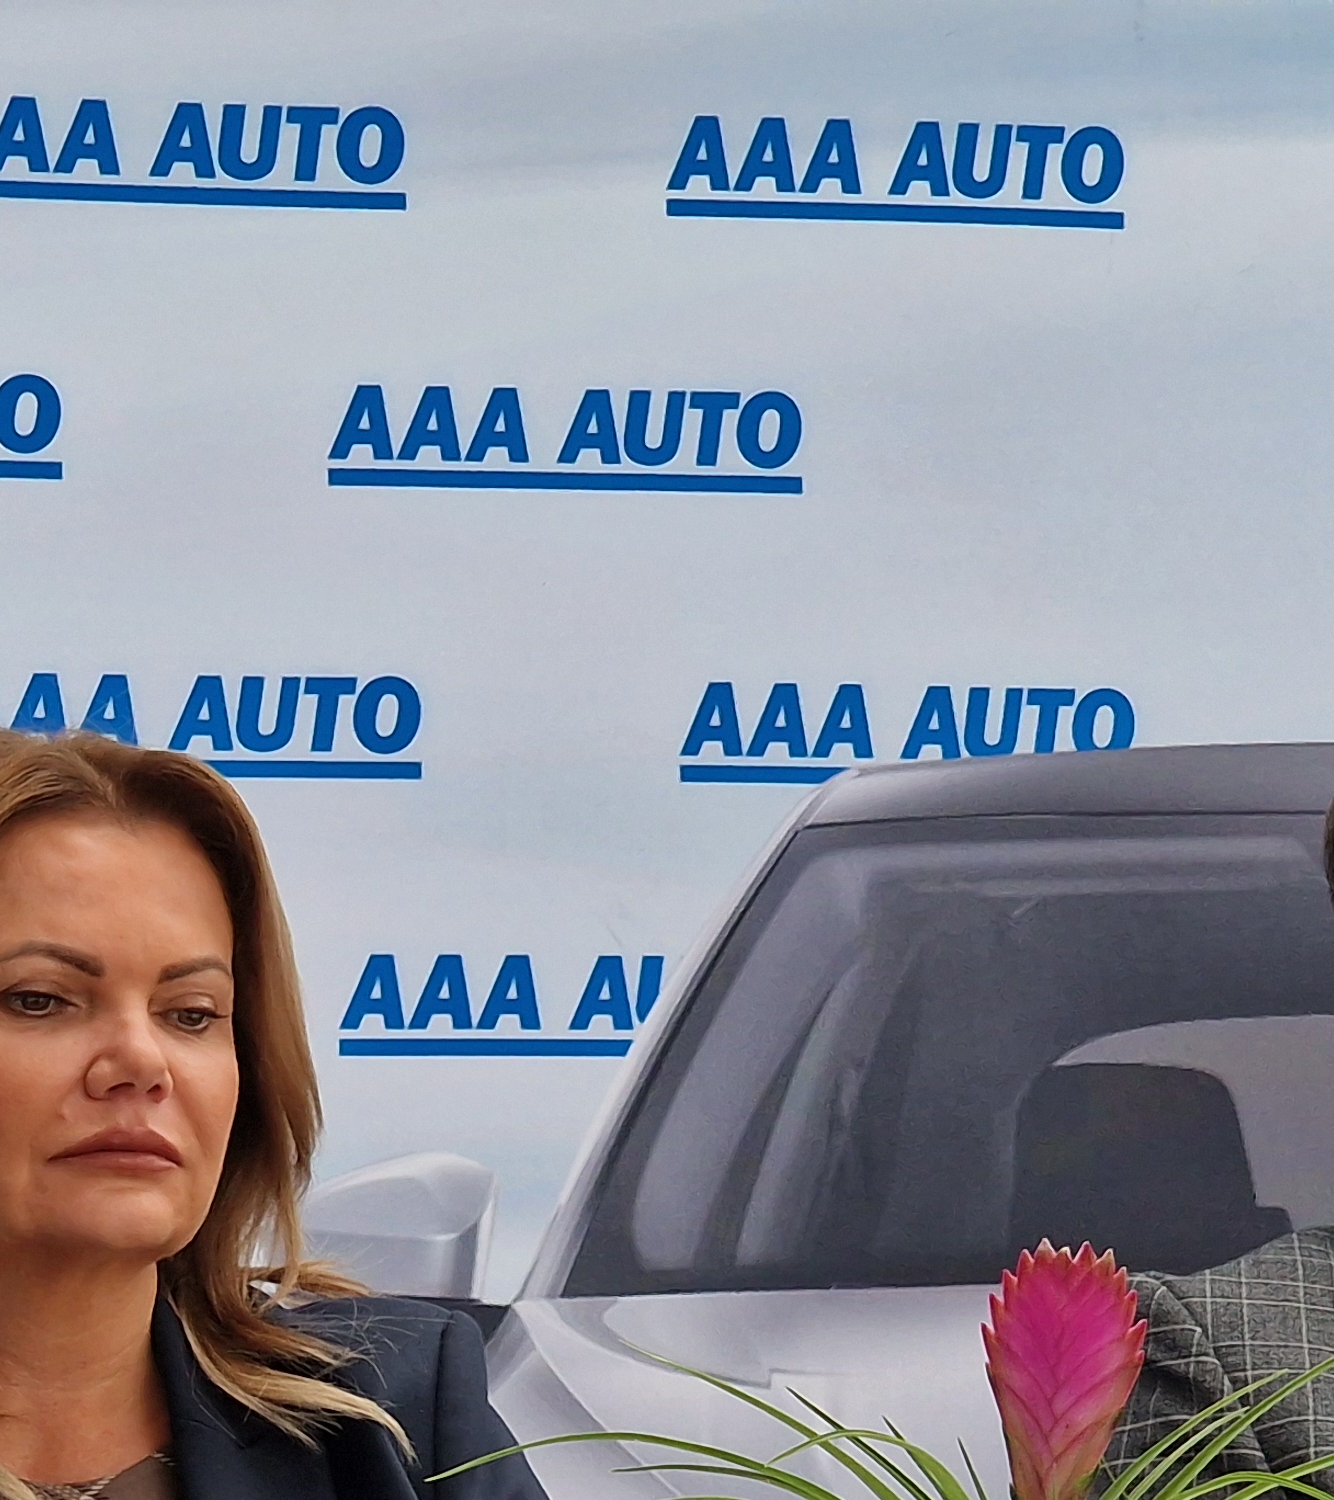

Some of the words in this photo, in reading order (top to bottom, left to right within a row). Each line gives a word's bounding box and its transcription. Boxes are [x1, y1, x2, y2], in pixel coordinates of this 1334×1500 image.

[149, 102, 405, 186] AUTO
[667, 115, 862, 195] AAA
[888, 121, 1125, 205] AUTO
[328, 385, 532, 464] AAA
[557, 389, 802, 470] AUTO
[168, 675, 422, 755] AUTO
[680, 681, 874, 759] AAA
[900, 685, 1135, 761] AUTO
[340, 954, 541, 1031] AAA
